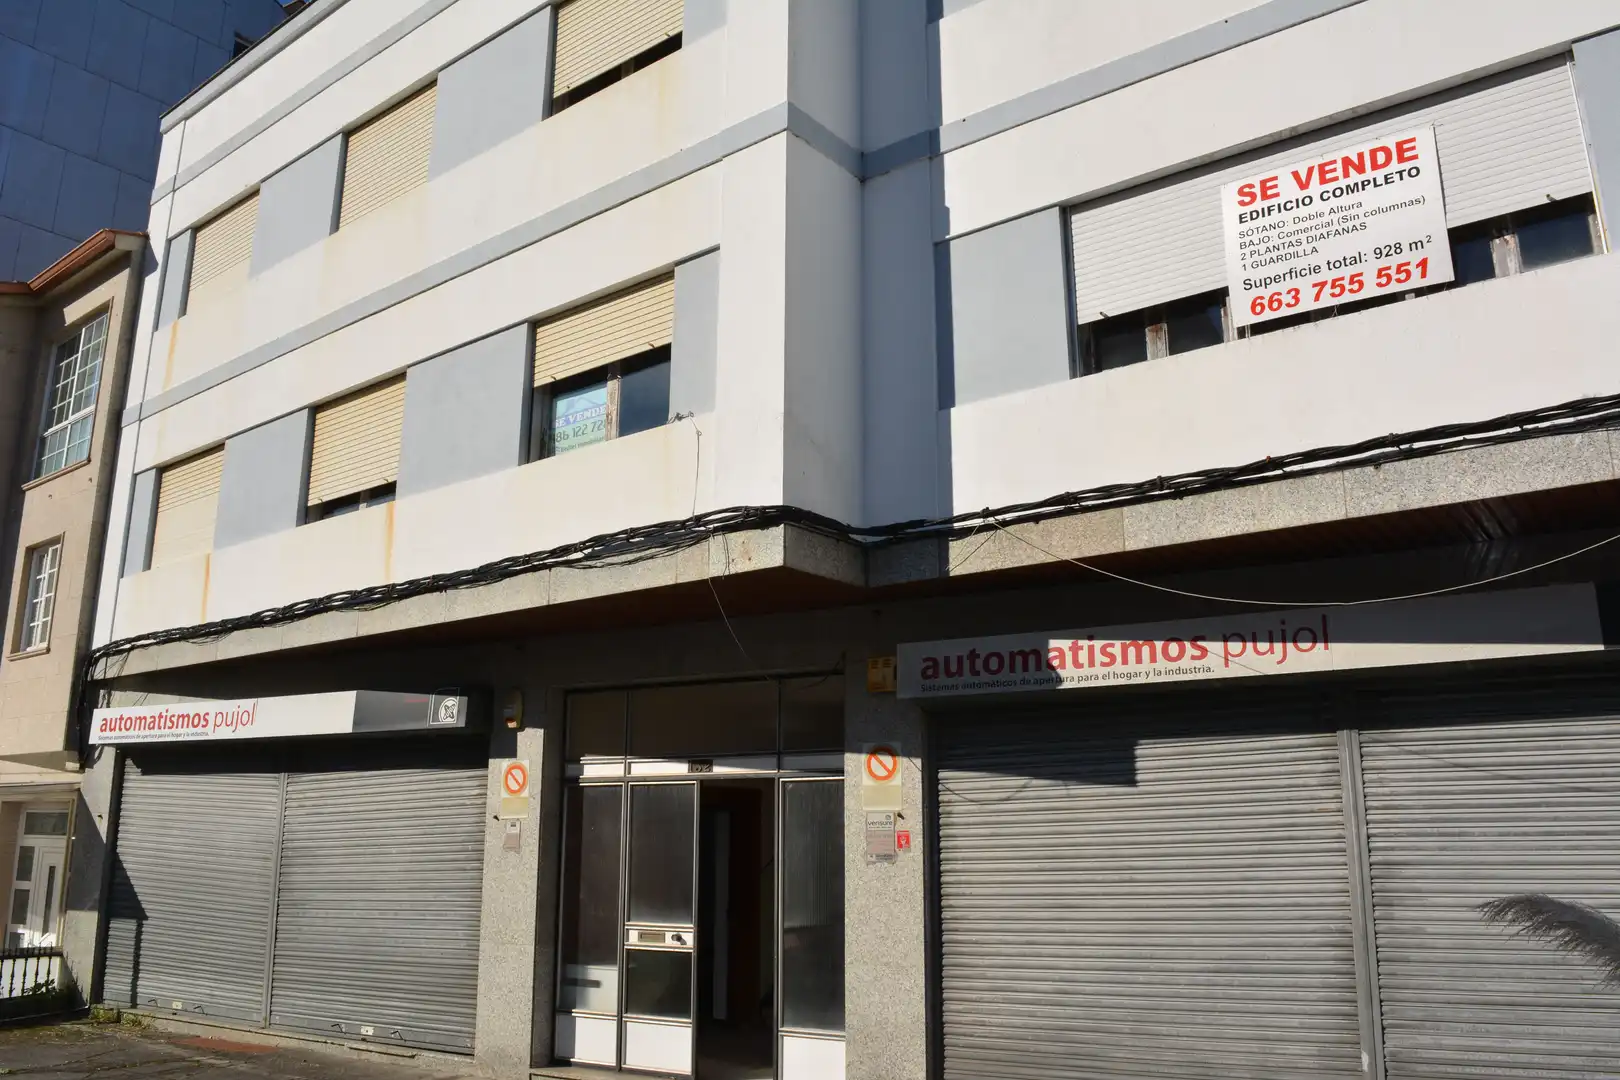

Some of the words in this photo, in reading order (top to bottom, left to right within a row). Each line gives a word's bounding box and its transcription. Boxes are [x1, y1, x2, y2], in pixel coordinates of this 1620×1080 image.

[1237, 176, 1280, 207] SE
[1291, 136, 1419, 191] VENDE
[1238, 195, 1313, 225] EDIFICIO
[1319, 166, 1421, 202] COMPLETO
[1292, 211, 1325, 225] Doble
[1328, 201, 1363, 216] Altura
[1239, 235, 1274, 250] BAJO:
[1277, 218, 1334, 240] Comercial
[1337, 212, 1360, 226] (Sin
[1363, 194, 1426, 218] columnas)
[1240, 252, 1247, 261] 2
[1249, 238, 1303, 259] PLANTAS
[1306, 221, 1367, 245] DIAFANAS
[1242, 263, 1247, 271] 1
[1250, 246, 1319, 270] GUARDILLA
[1243, 263, 1322, 291] Superficie
[1326, 251, 1368, 271] total:
[1373, 242, 1403, 260] 928
[1250, 287, 1301, 316] 663
[1311, 272, 1365, 303] 755
[1375, 257, 1428, 288] 551
[591, 419, 606, 433] 72
[920, 635, 1209, 680] automatismos
[1223, 614, 1329, 668] pujol
[920, 682, 959, 692] Sistemas
[1020, 677, 1031, 685] de
[1077, 674, 1099, 684] para
[1101, 671, 1111, 681] el
[1112, 670, 1142, 683] hogar
[1144, 670, 1151, 679] y
[1153, 668, 1162, 677] la
[1164, 664, 1215, 676] industria.
[99, 708, 210, 733] automatismos
[213, 702, 256, 734] pujol
